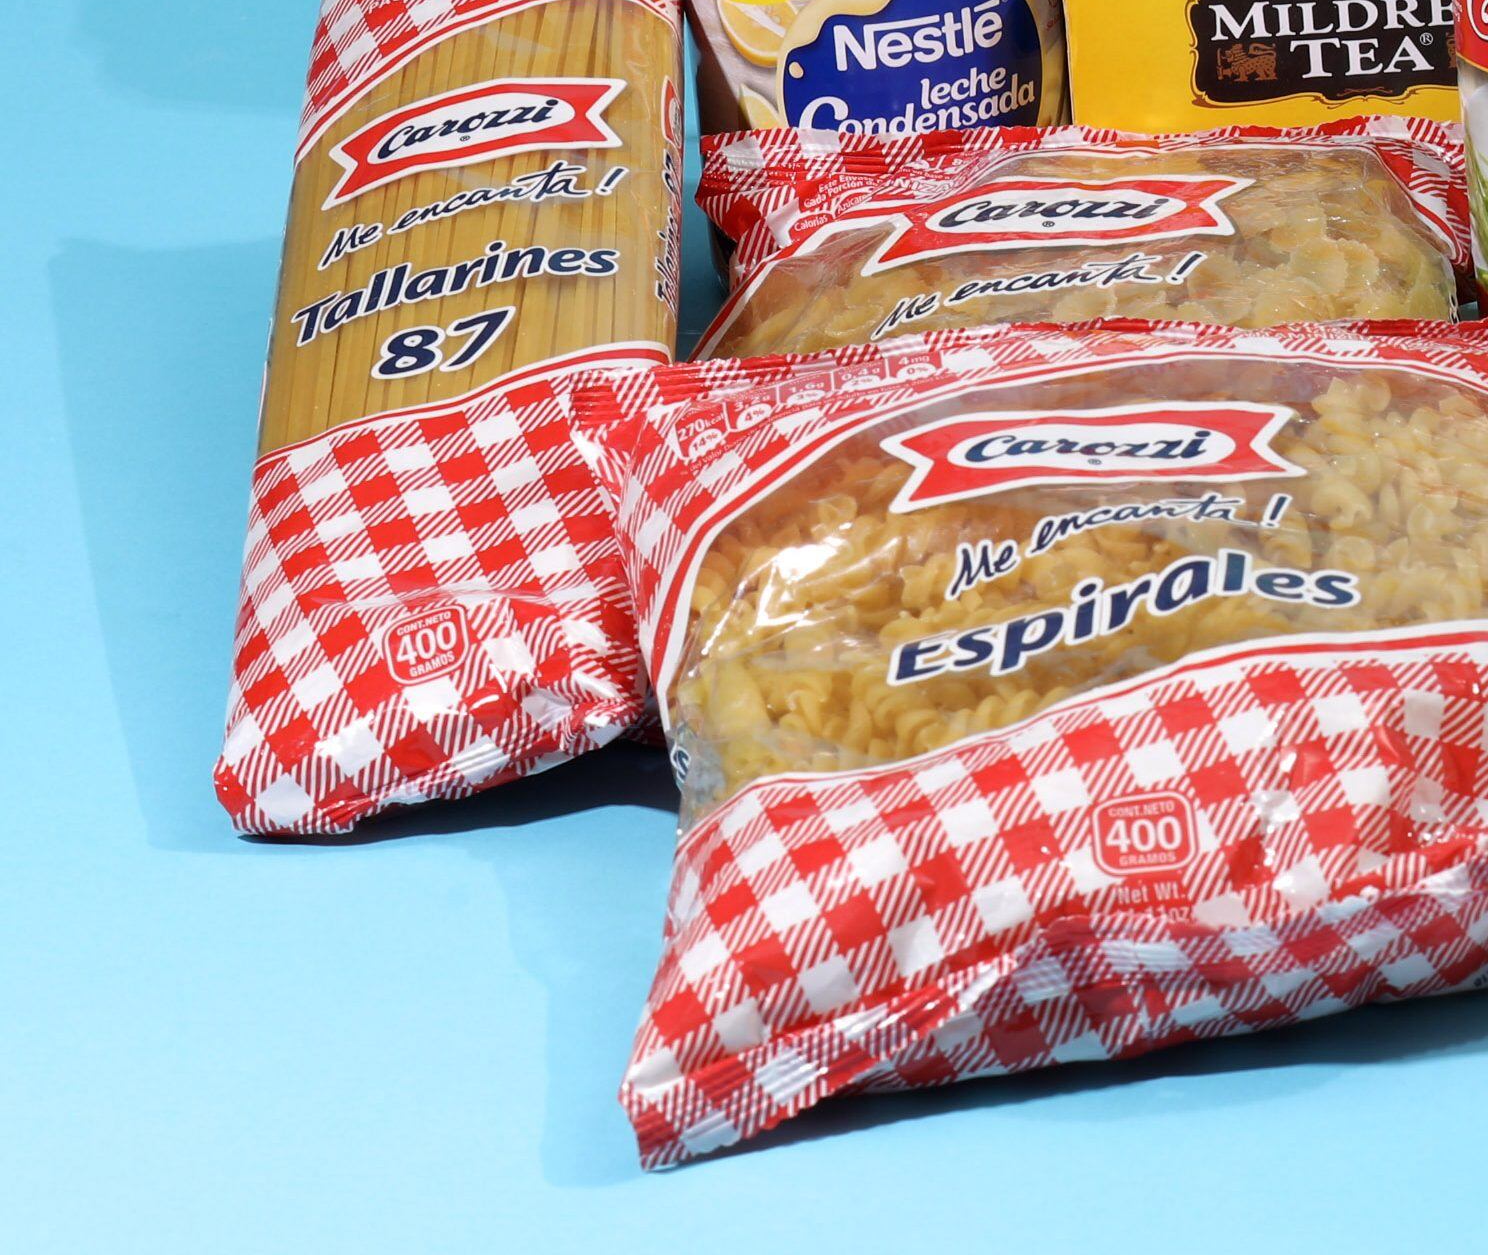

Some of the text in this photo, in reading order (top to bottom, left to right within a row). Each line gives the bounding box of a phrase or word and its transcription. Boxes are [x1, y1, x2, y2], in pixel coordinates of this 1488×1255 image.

[1290, 40, 1434, 79] TEA
[799, 79, 1035, 134] Condensada
[921, 66, 1006, 109] leche
[376, 99, 559, 161] Carozzi
[321, 161, 590, 269] Me encanta
[937, 196, 1169, 228] Carozzi
[294, 242, 620, 346] Tallarines
[872, 253, 1160, 340] Me encanta
[373, 307, 514, 380] 87
[964, 430, 1211, 463] Carozzi
[948, 494, 1236, 597] Me encanta
[887, 554, 1359, 687] Espirales
[397, 624, 458, 662] 400
[409, 651, 455, 676] GRAMOS
[1105, 816, 1182, 853] 400
[1119, 852, 1176, 866] GRAMOS
[1118, 886, 1148, 904] Net
